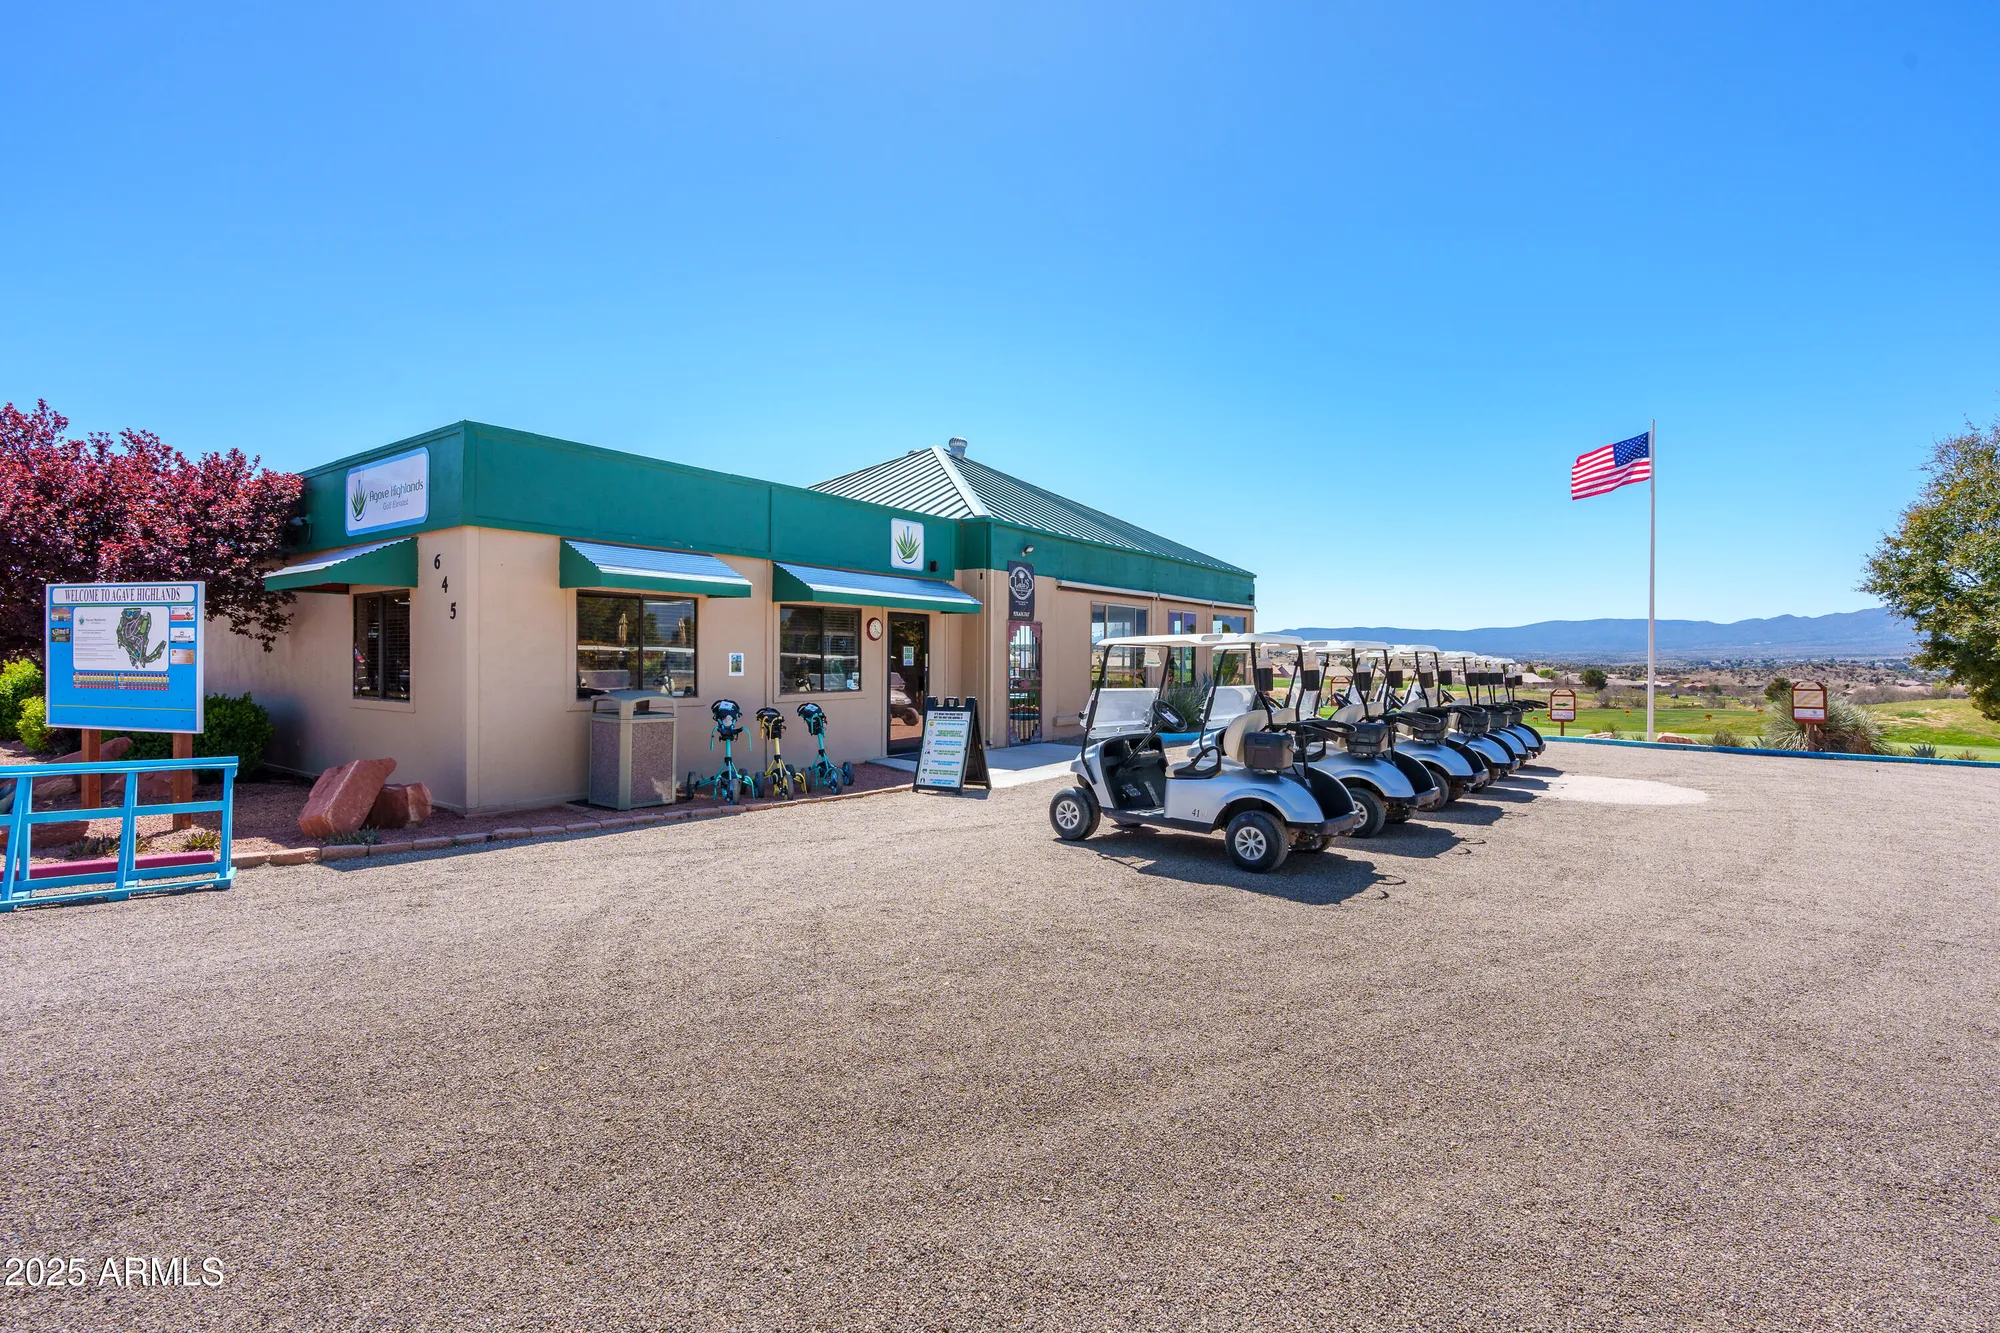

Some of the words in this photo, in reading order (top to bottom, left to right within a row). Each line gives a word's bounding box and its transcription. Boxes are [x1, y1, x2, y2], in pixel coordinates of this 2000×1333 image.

[369, 490, 389, 503] Agave
[391, 479, 424, 498] Highlands
[383, 502, 392, 510] Golf
[65, 589, 99, 602] WELCOME
[100, 589, 110, 602] TO
[112, 588, 135, 601] AGAVE
[137, 587, 181, 601] HIGHLANDS
[1191, 808, 1199, 817] 41
